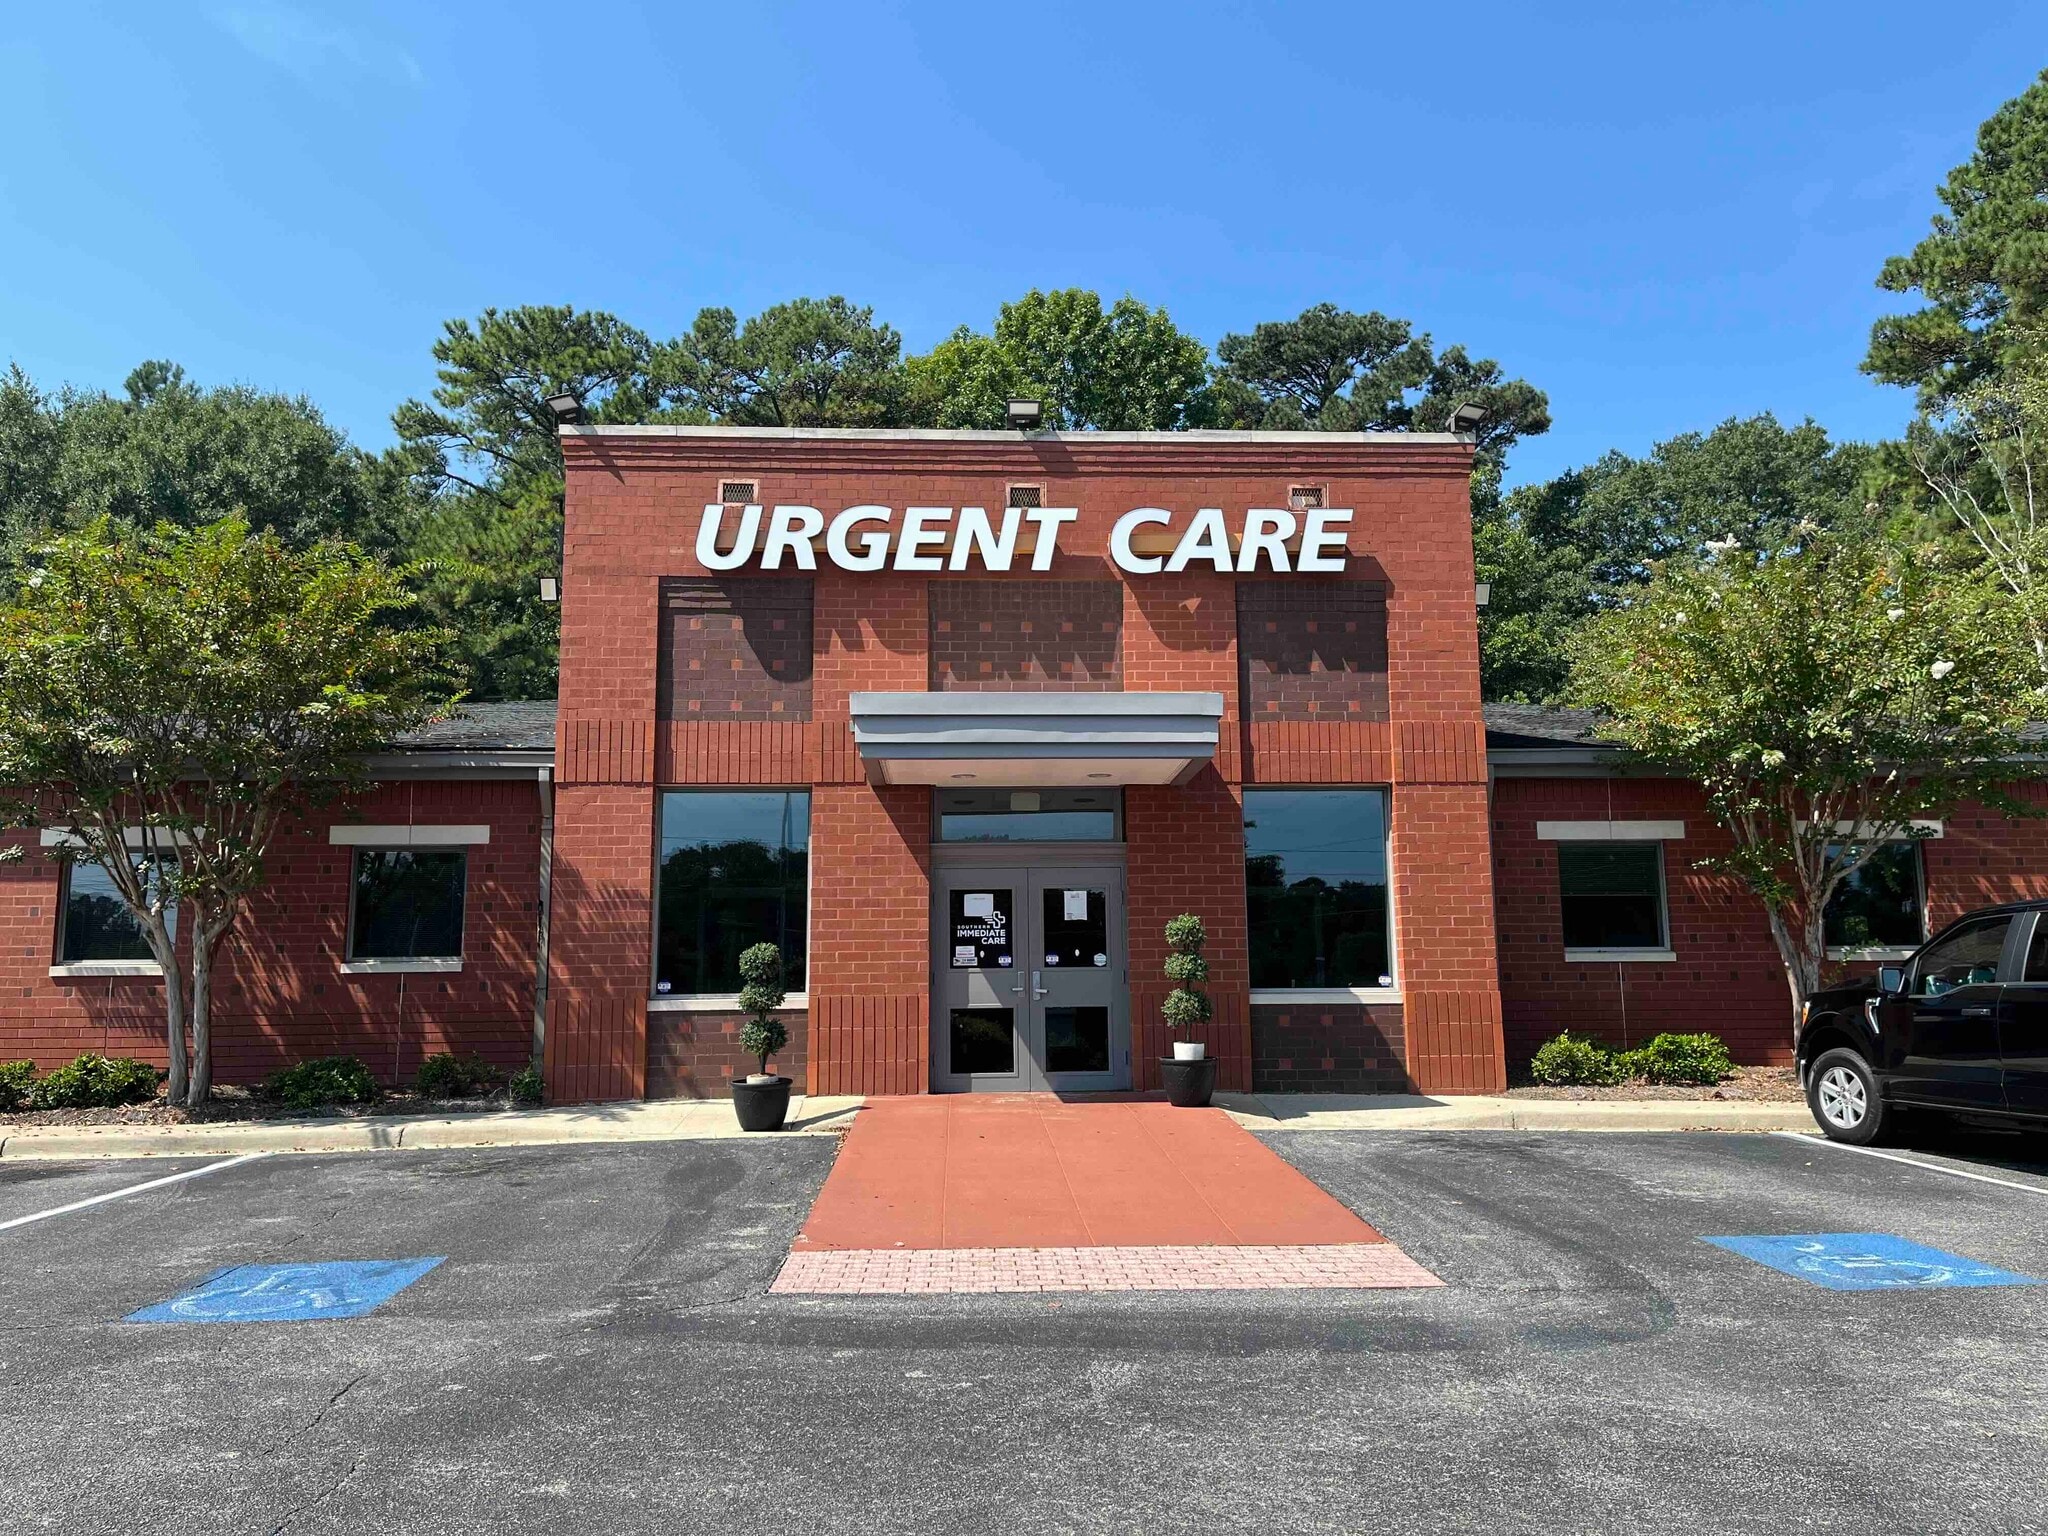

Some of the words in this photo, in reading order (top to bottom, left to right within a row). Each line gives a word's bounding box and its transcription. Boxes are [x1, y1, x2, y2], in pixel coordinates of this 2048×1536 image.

[695, 503, 1079, 573] URGENT
[1109, 507, 1354, 575] CARE
[957, 929, 1006, 937] IMMEDIATE
[981, 937, 1006, 945] CARE
